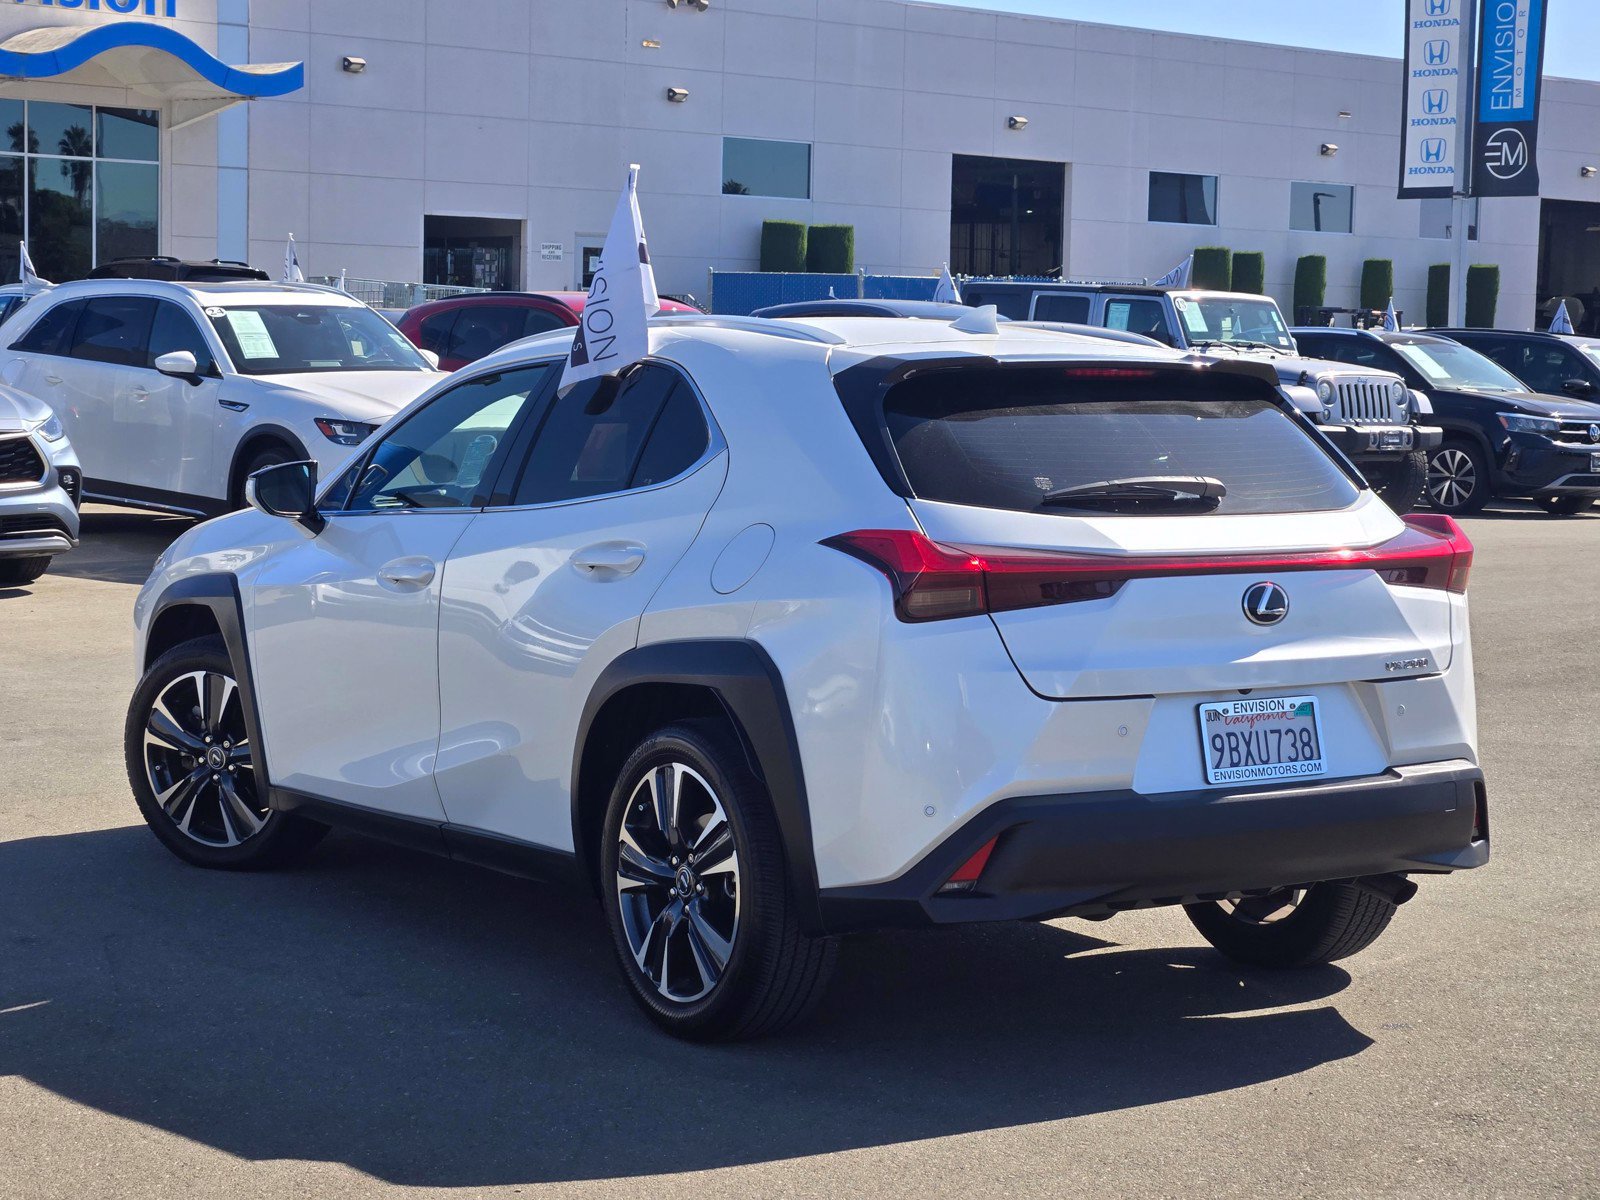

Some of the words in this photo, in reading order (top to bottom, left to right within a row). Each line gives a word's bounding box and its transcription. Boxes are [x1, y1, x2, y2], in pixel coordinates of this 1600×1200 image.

[1413, 18, 1461, 29] HONDA
[1412, 67, 1459, 78] HONDA
[1410, 116, 1457, 127] HONDA
[1408, 166, 1455, 175] HONDA
[1233, 699, 1285, 714] ENVISION
[1205, 711, 1221, 722] JUN
[1211, 726, 1315, 770] 9BXU738
[1213, 762, 1322, 781] ENVISIONMOTORS.COM
